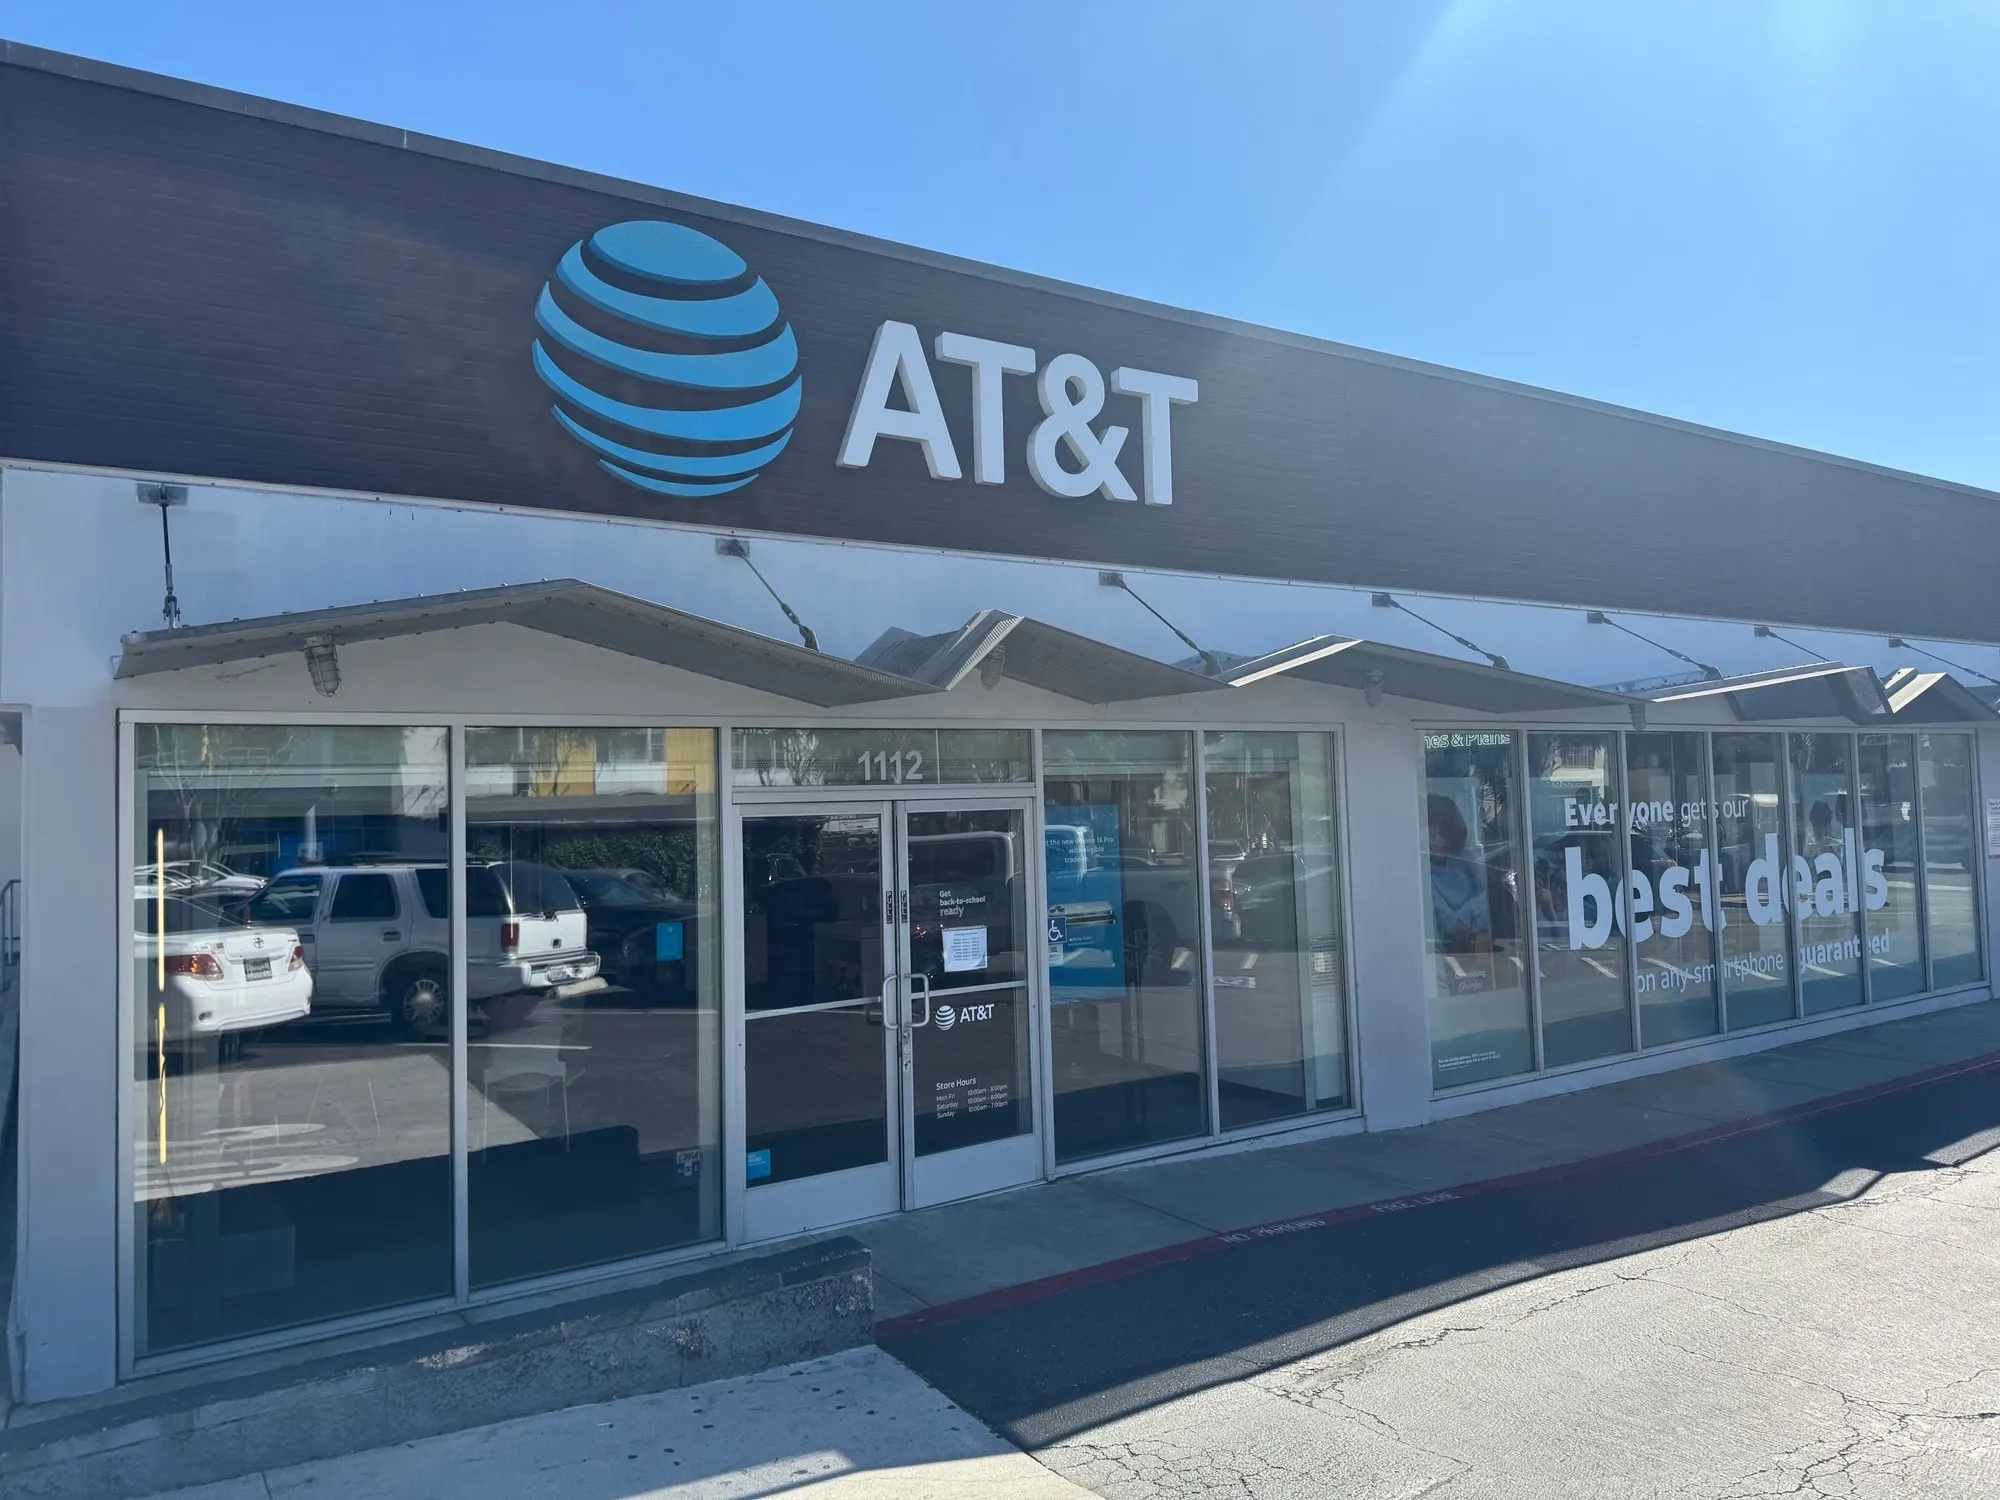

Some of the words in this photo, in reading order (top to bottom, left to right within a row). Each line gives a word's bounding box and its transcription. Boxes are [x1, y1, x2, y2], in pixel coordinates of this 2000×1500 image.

[836, 320, 1199, 507] AT&T
[858, 751, 923, 780] 1112
[1723, 800, 1749, 818] our
[1565, 846, 1727, 950] best
[1745, 828, 1888, 926] deals
[940, 896, 986, 906] back-to-school
[940, 906, 964, 918] ready
[1637, 973, 1656, 993] on
[1661, 969, 1689, 993] any
[1694, 952, 1784, 984] smrtphone
[960, 1004, 995, 1023] AT&T
[936, 1081, 956, 1091] Store
[956, 1078, 977, 1087] Hours
[936, 1093, 956, 1102] Mon-Fri
[968, 1088, 987, 1096] 10:00am
[937, 1102, 958, 1111] Saturday
[968, 1096, 987, 1104] 10:00am
[937, 1111, 955, 1119] Sunday
[1218, 1233, 1251, 1244] NO
[1251, 1219, 1326, 1237] PARKING
